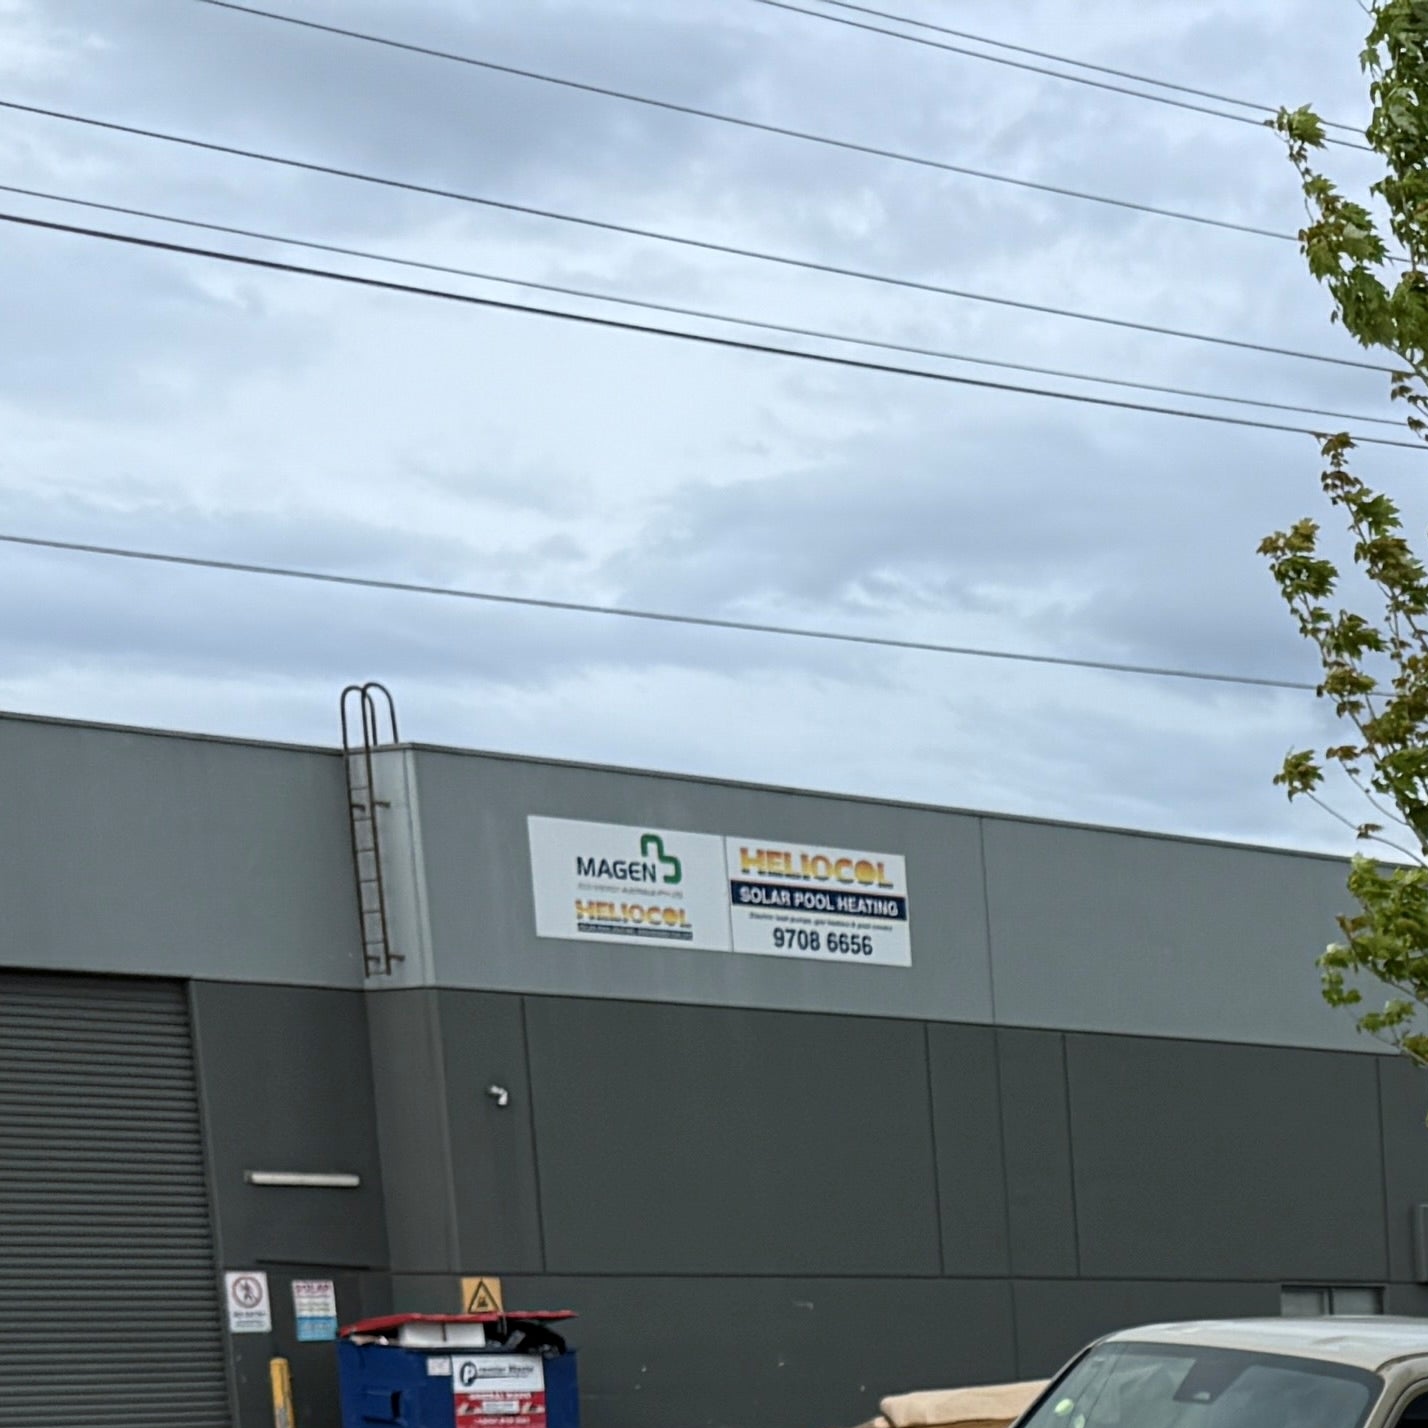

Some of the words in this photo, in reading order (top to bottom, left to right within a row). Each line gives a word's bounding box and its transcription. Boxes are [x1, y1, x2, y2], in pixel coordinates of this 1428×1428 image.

[577, 857, 656, 883] MAGEN
[740, 847, 894, 889] HELIOCOL
[575, 899, 692, 928] HELIOCOL
[739, 886, 790, 906] SOLAR
[793, 892, 835, 911] POOL
[837, 896, 898, 917] HEATING
[773, 927, 820, 952] 9708
[827, 932, 873, 956] 6656
